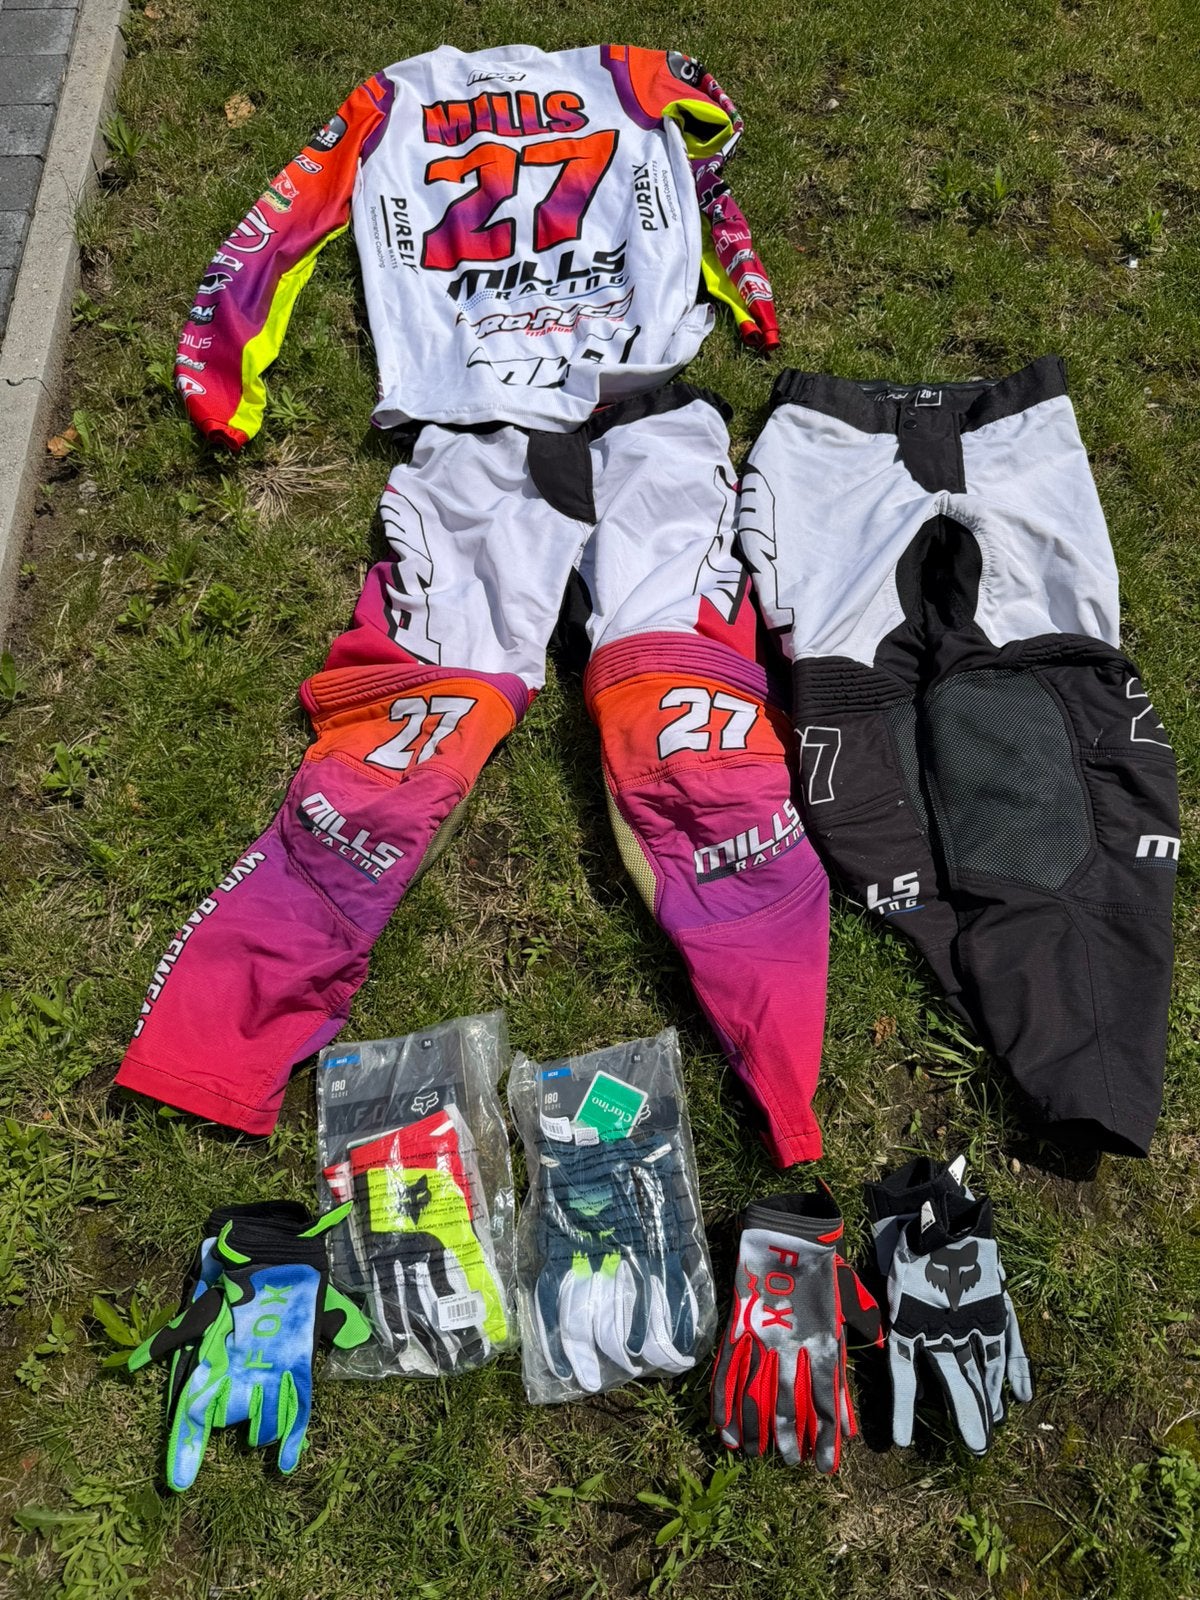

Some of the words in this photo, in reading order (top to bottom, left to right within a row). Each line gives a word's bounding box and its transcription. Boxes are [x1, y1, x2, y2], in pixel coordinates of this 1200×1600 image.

[421, 91, 590, 146] MILLS
[420, 129, 620, 270] 27
[632, 162, 658, 231] PURELY
[370, 206, 380, 240] Performance
[375, 240, 385, 269] Coaching
[388, 248, 398, 269] WATTS
[390, 197, 419, 275] PURELY
[446, 239, 627, 302] MILLS
[495, 272, 625, 300] RACING
[525, 324, 574, 338] TITANIUM
[364, 695, 478, 771] 27
[657, 687, 759, 761] 27
[301, 792, 405, 870] MILLS
[312, 826, 384, 878] RACING
[694, 798, 801, 874] MILLS
[331, 1080, 346, 1092] 180
[545, 1092, 558, 1104] 180
[591, 1095, 634, 1123] Clarino
[762, 1245, 799, 1330] FOX
[244, 1283, 293, 1369] FOX
